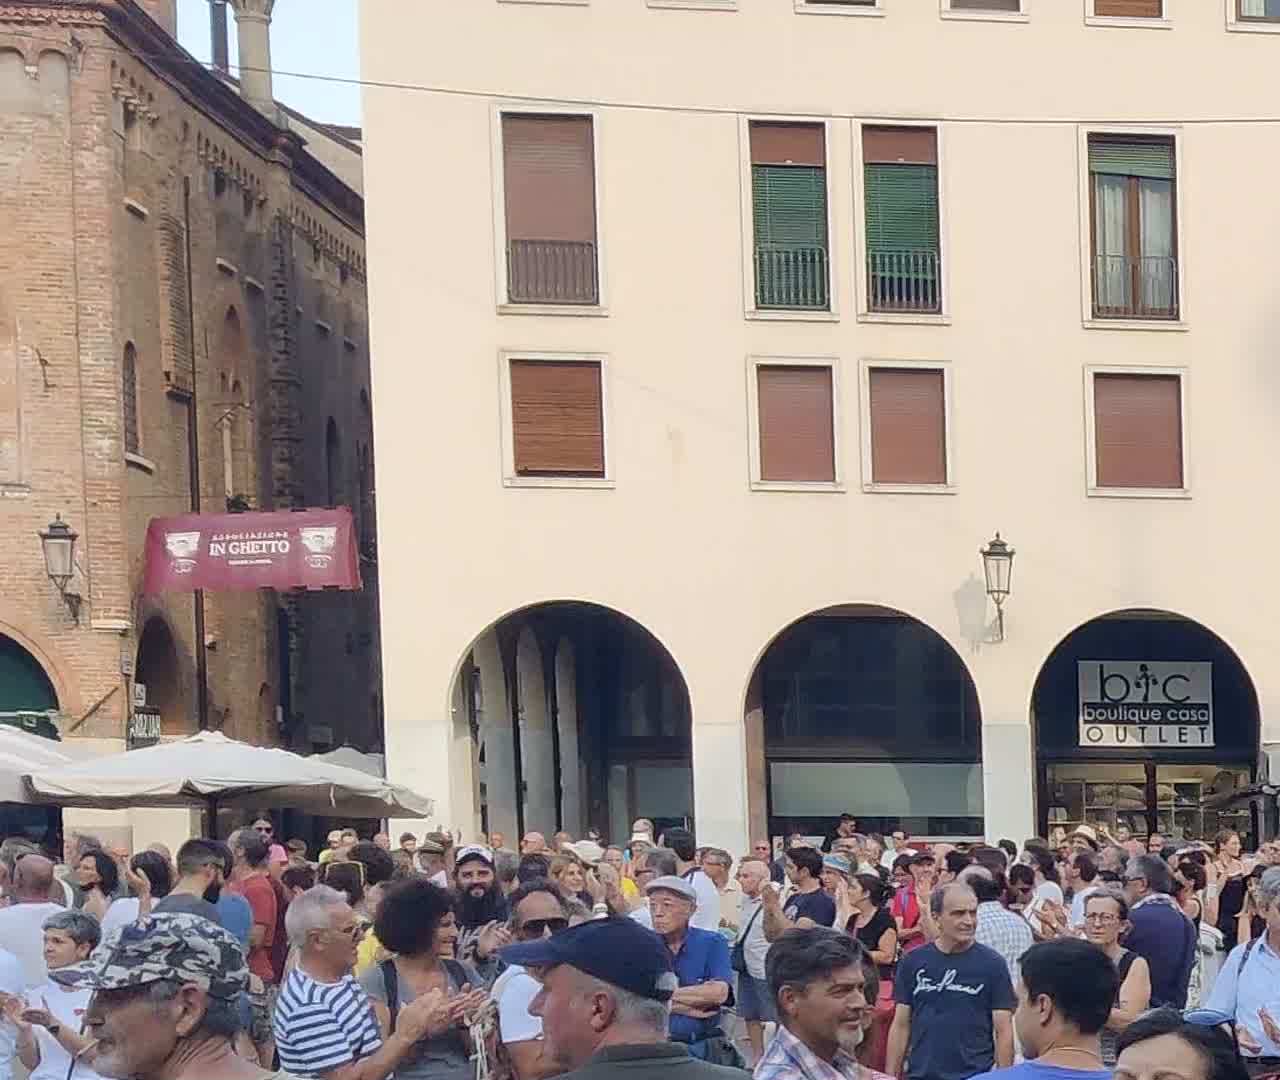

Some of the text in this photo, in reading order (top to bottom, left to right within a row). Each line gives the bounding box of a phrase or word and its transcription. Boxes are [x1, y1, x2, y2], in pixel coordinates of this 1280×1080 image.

[209, 540, 290, 556] IN GHETTO
[1084, 704, 1209, 722] boutique casa
[1086, 726, 1208, 743] OUTLET
